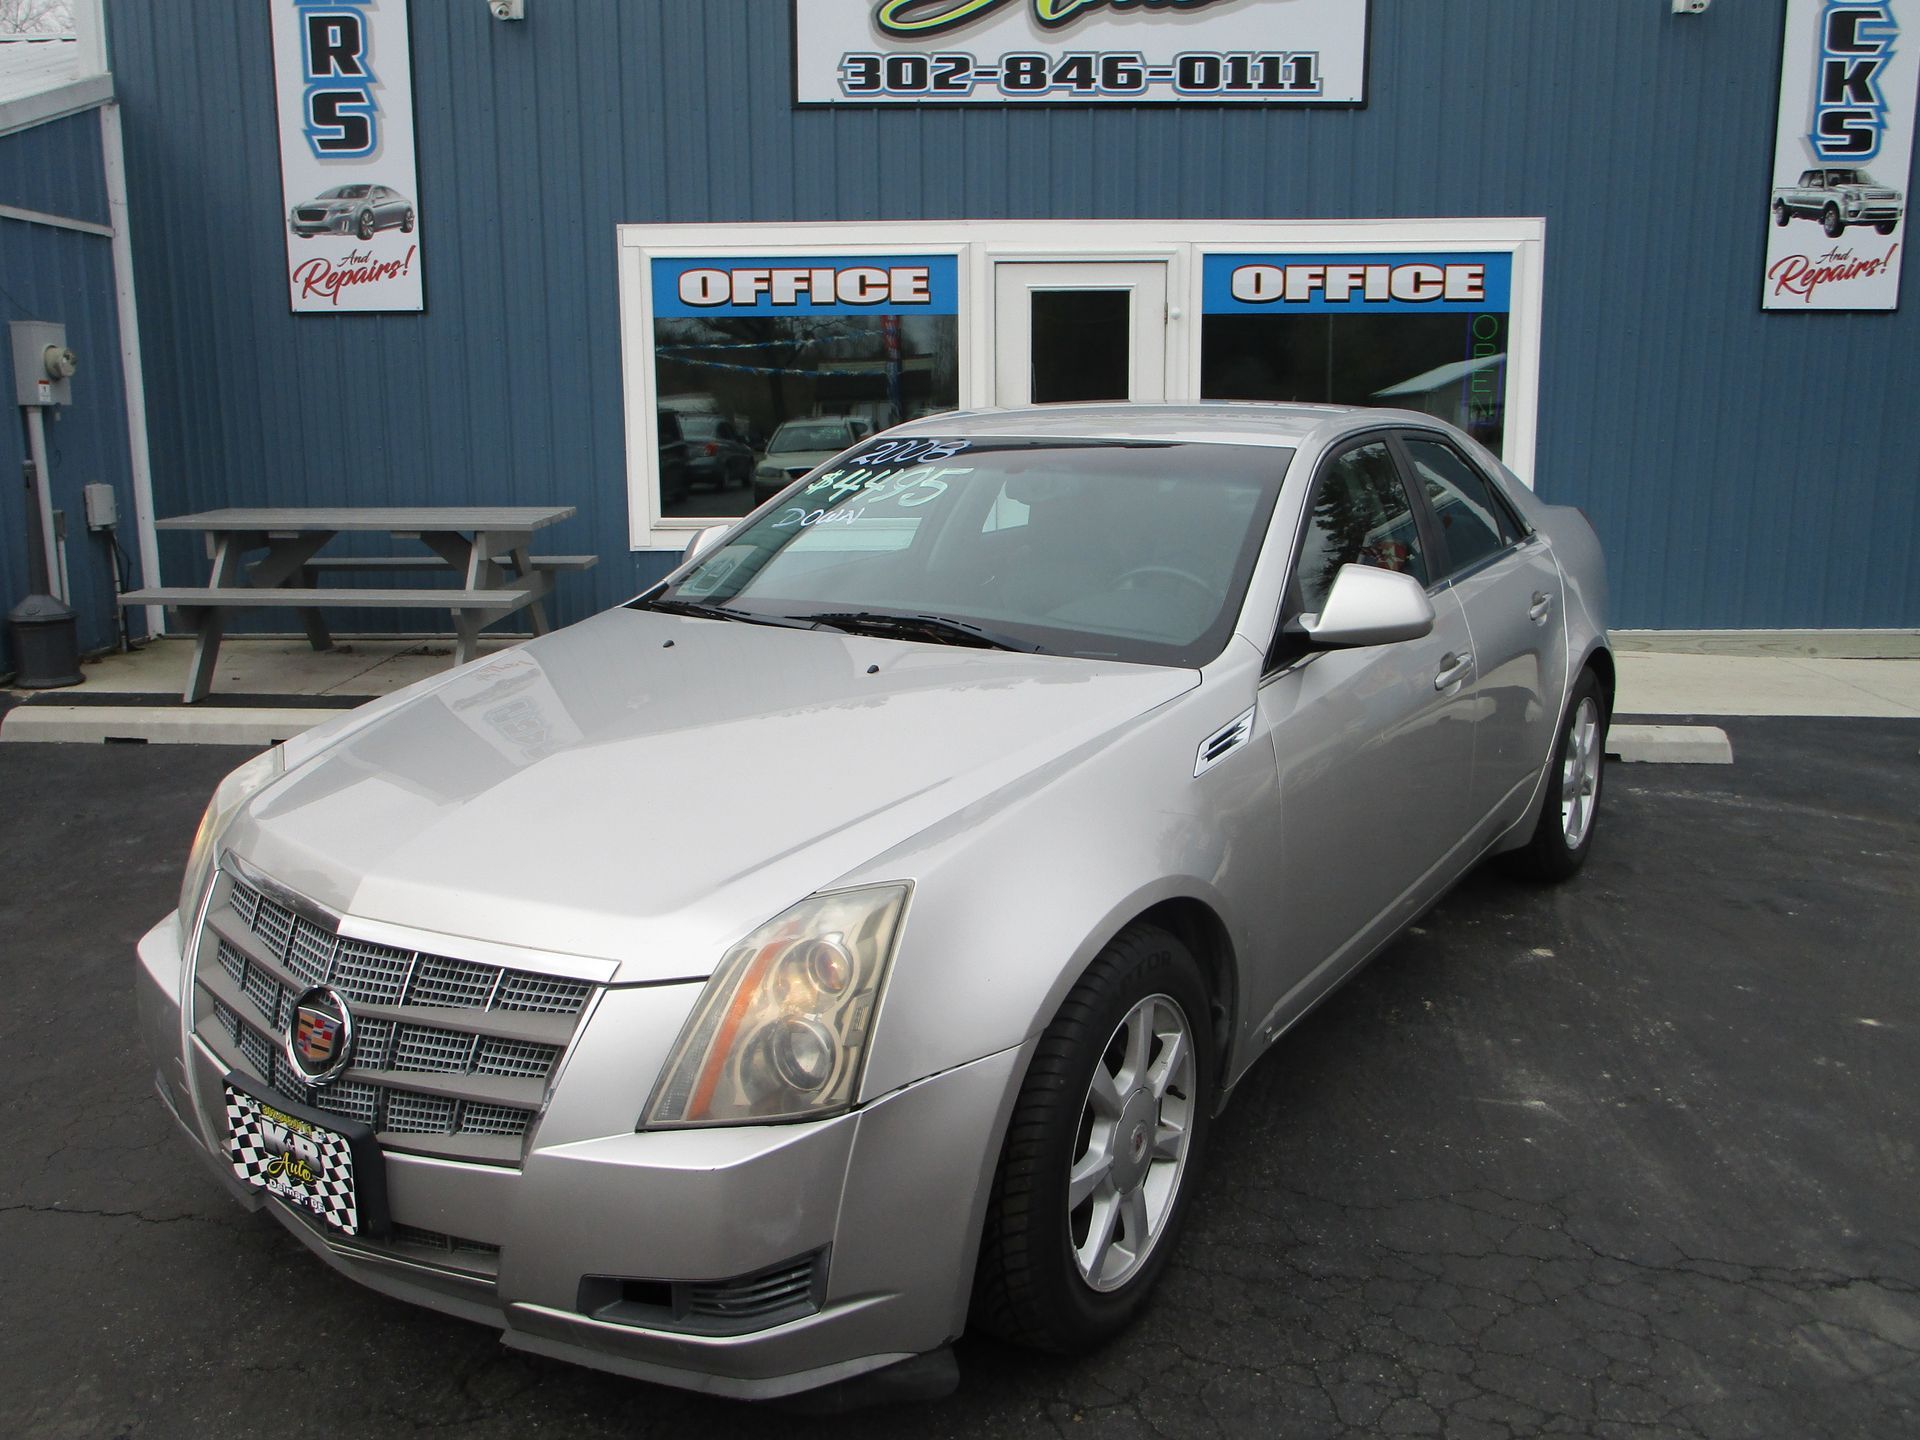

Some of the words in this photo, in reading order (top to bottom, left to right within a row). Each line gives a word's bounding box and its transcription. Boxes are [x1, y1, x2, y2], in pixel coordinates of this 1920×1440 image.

[302, 0, 375, 156] RS
[841, 53, 1320, 95] 302-846-0111
[1815, 0, 1892, 158] CKS
[292, 244, 416, 305] Repairs!
[337, 248, 373, 267] And
[1767, 242, 1898, 303] Repairs!
[1815, 245, 1853, 264] And
[678, 267, 931, 307] OFFICE
[1231, 264, 1485, 304] OFFICE
[1469, 313, 1498, 419] OPEN
[849, 439, 973, 465] 2008
[804, 466, 975, 507] $4495
[771, 507, 866, 528] DOWN
[267, 1151, 314, 1182] Auto
